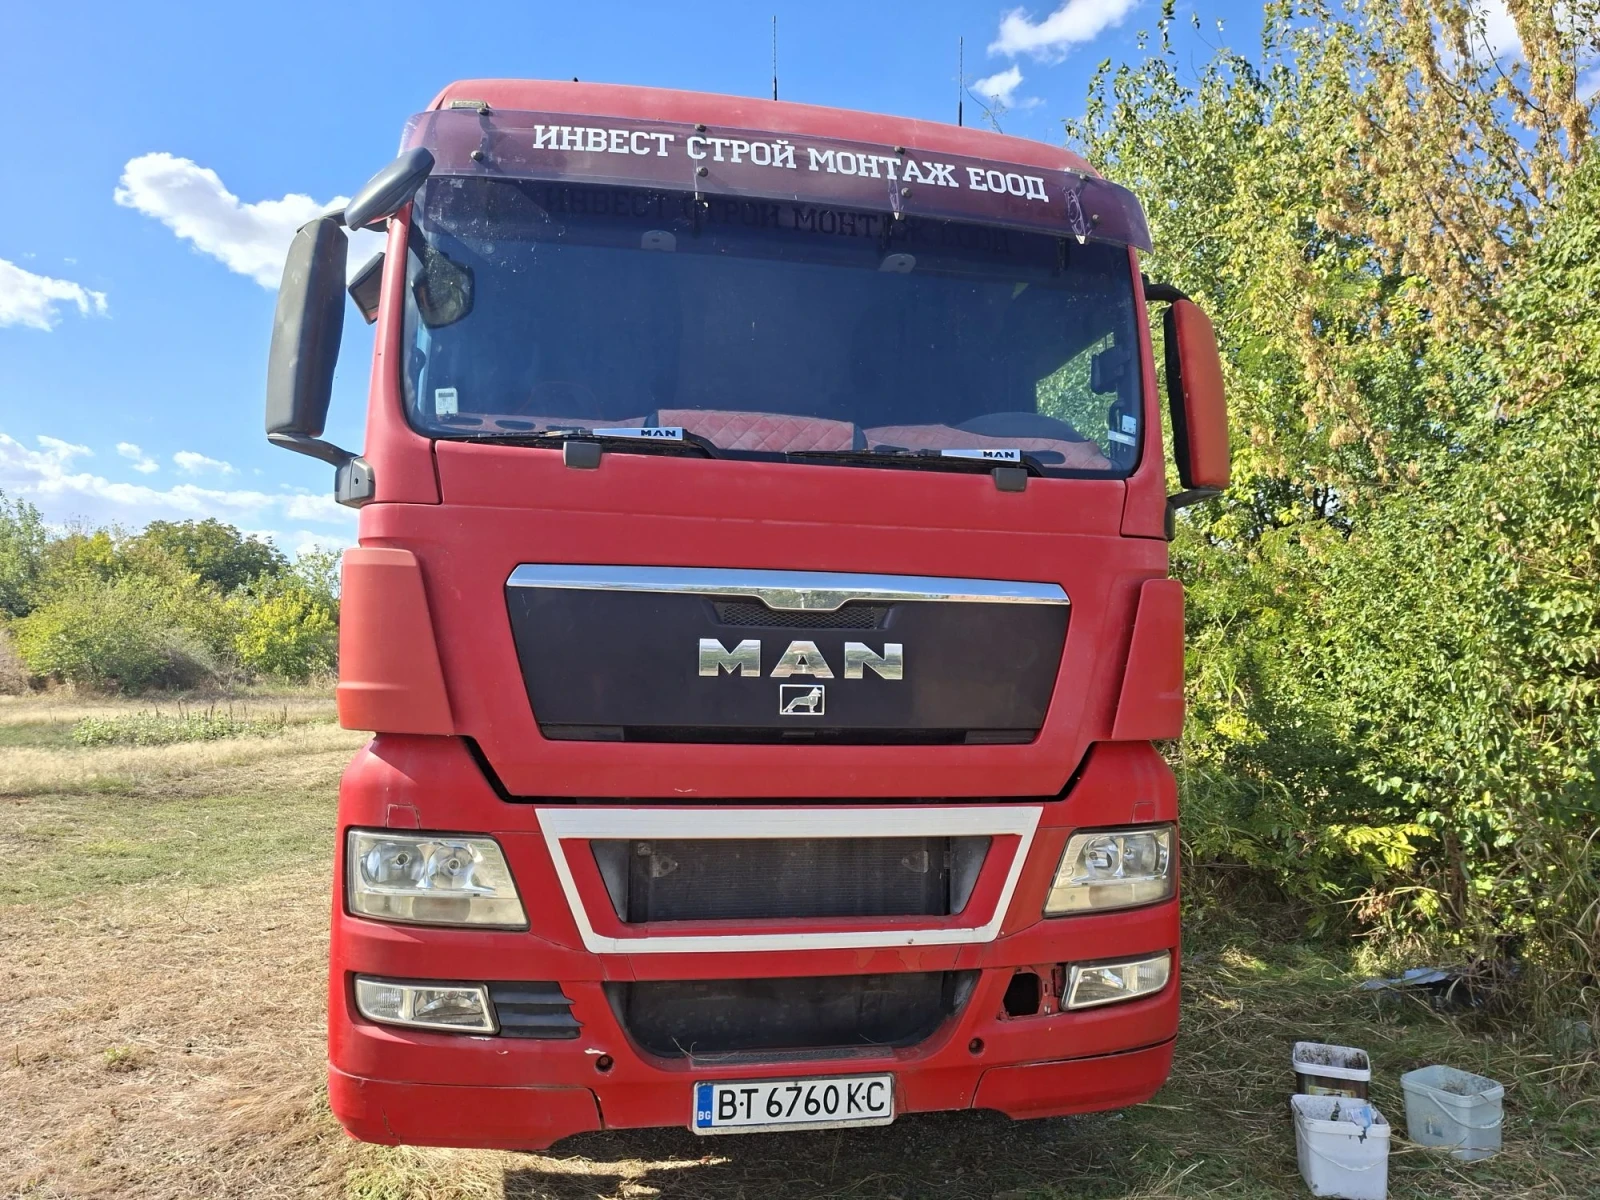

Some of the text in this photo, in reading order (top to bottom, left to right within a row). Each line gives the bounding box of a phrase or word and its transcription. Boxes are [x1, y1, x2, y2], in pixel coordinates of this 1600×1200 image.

[532, 124, 1049, 203] ИНВЕСТ СТРОЙ МОНТАЖ ЕООД
[640, 429, 676, 437] MAN
[983, 450, 1015, 458] MAN
[699, 638, 903, 680] MAN
[765, 1084, 840, 1118] 6760
[698, 1110, 712, 1121] BG
